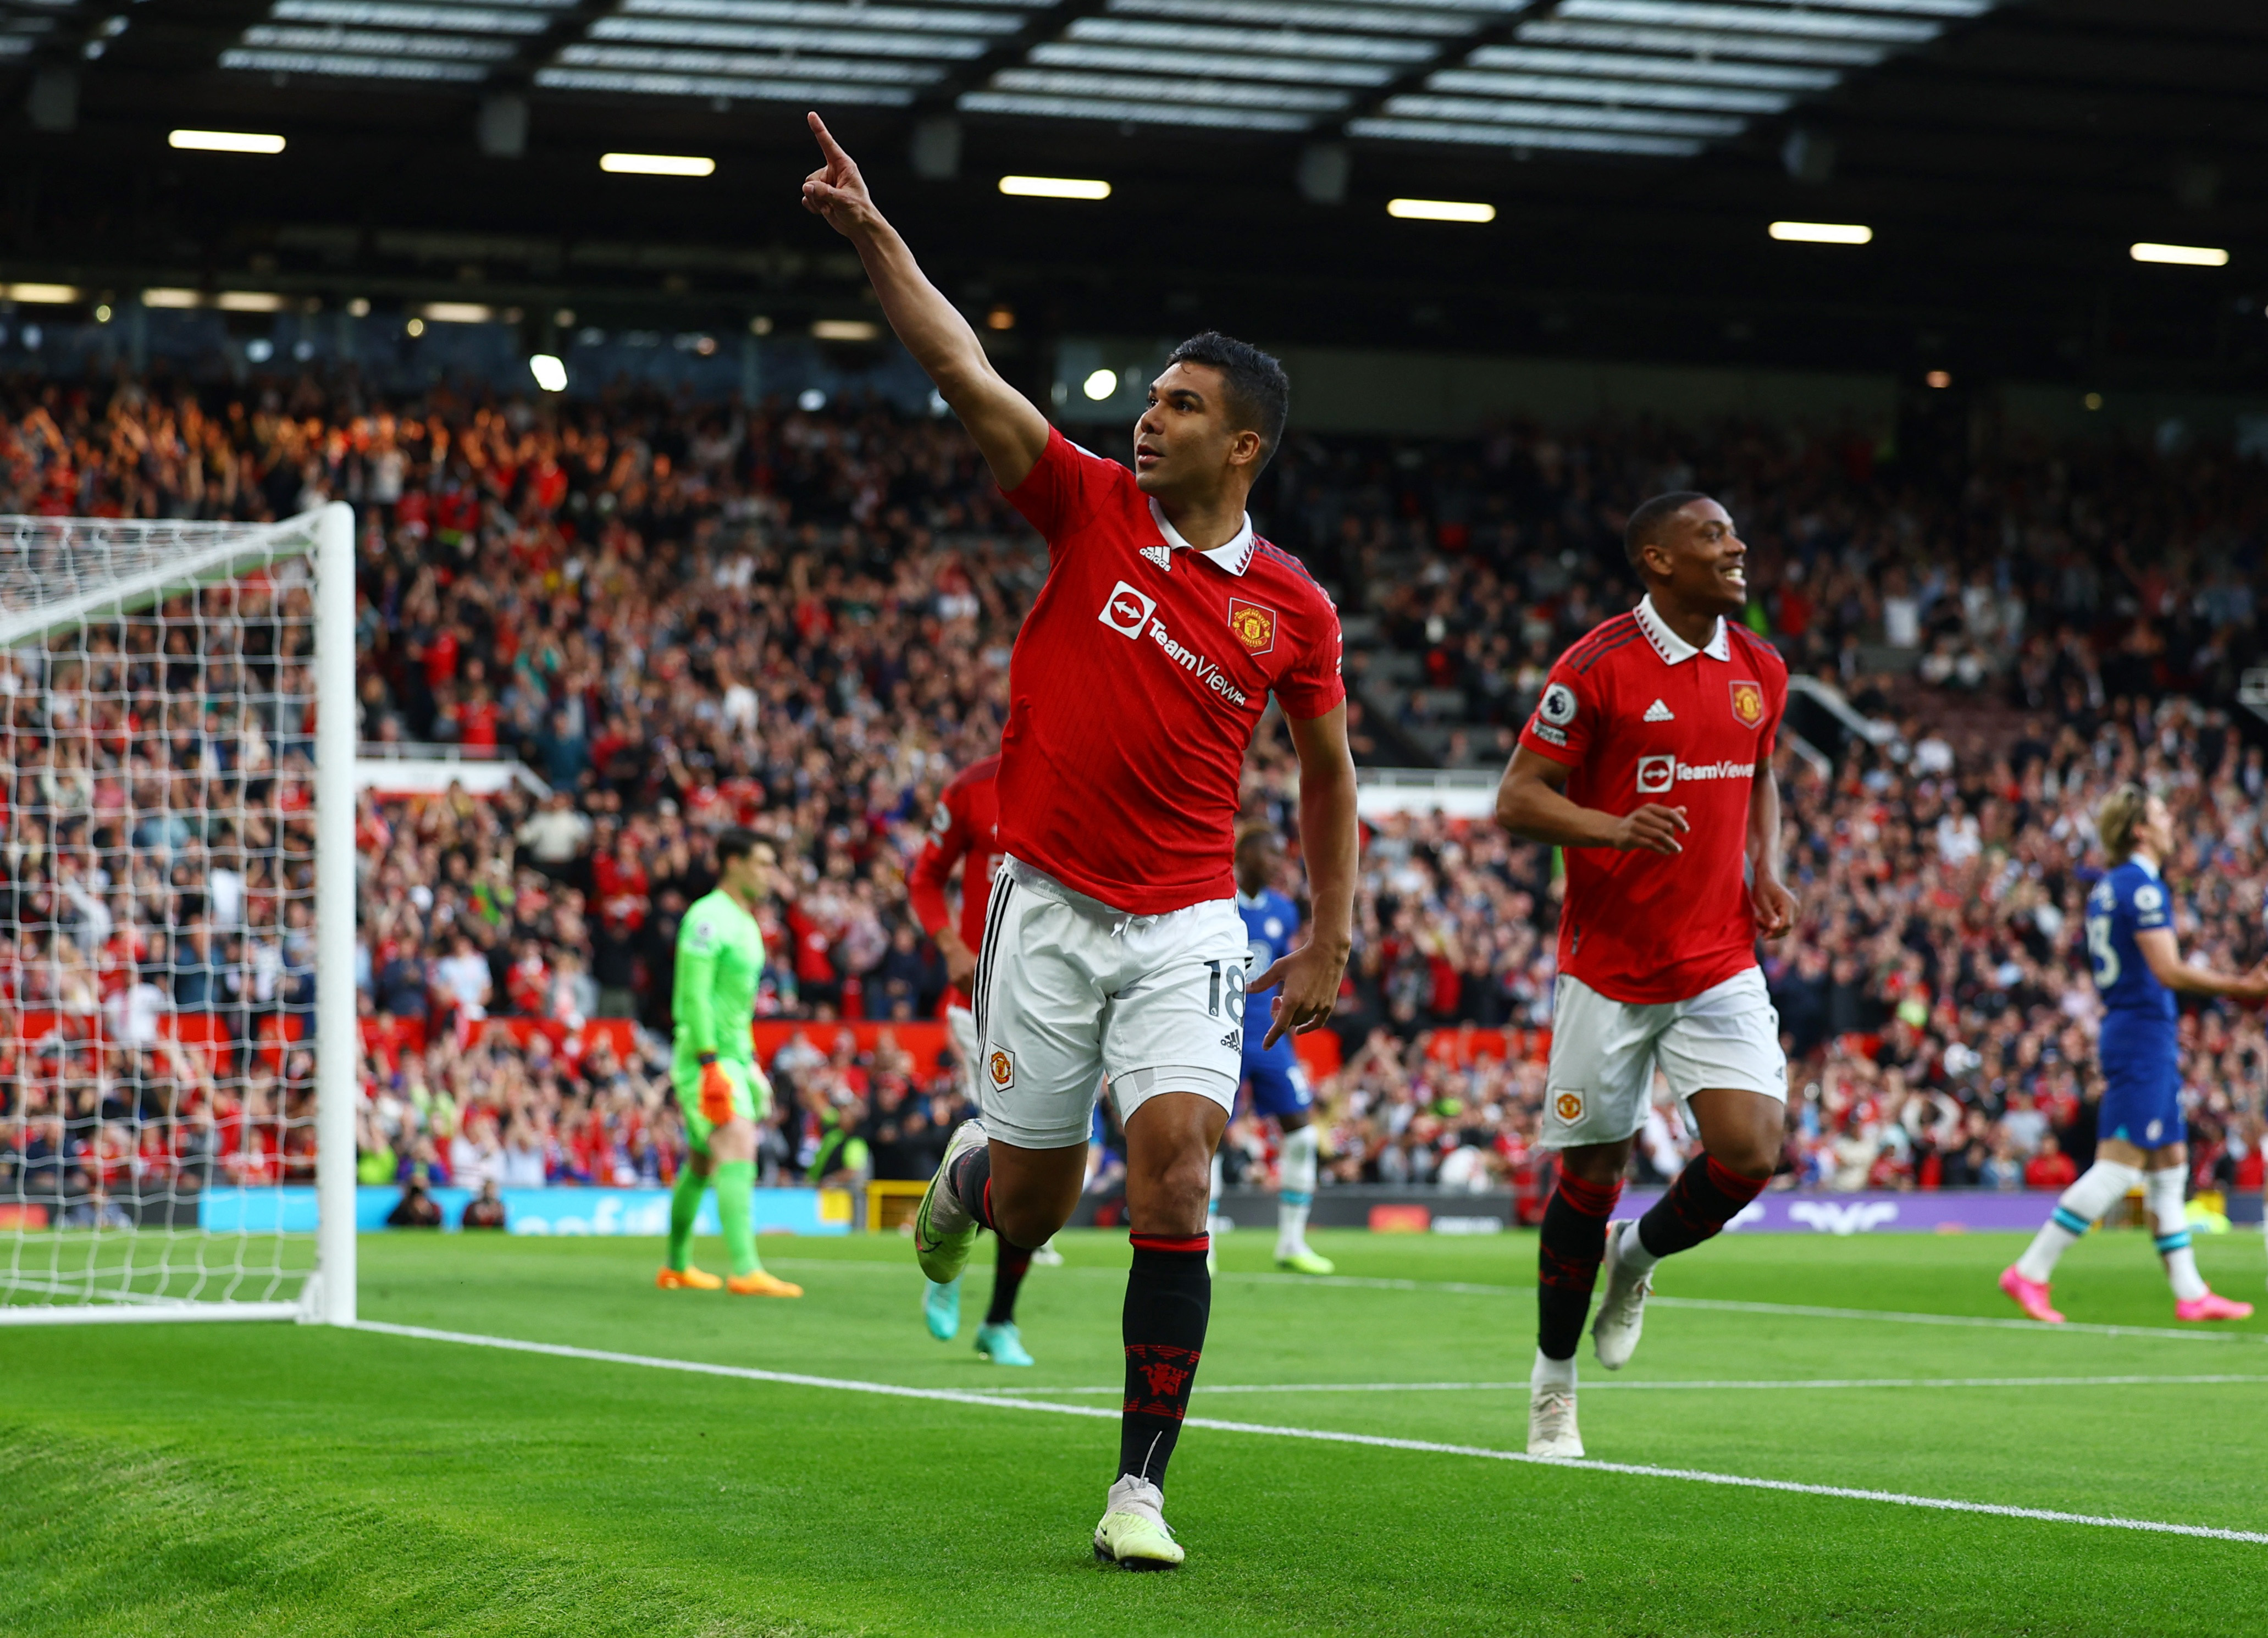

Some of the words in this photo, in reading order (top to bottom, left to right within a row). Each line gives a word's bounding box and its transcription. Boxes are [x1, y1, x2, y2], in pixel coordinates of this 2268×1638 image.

[1139, 547, 1171, 572] adidas
[1677, 760, 1755, 781] TeamViewe
[1204, 960, 1245, 1028] 18
